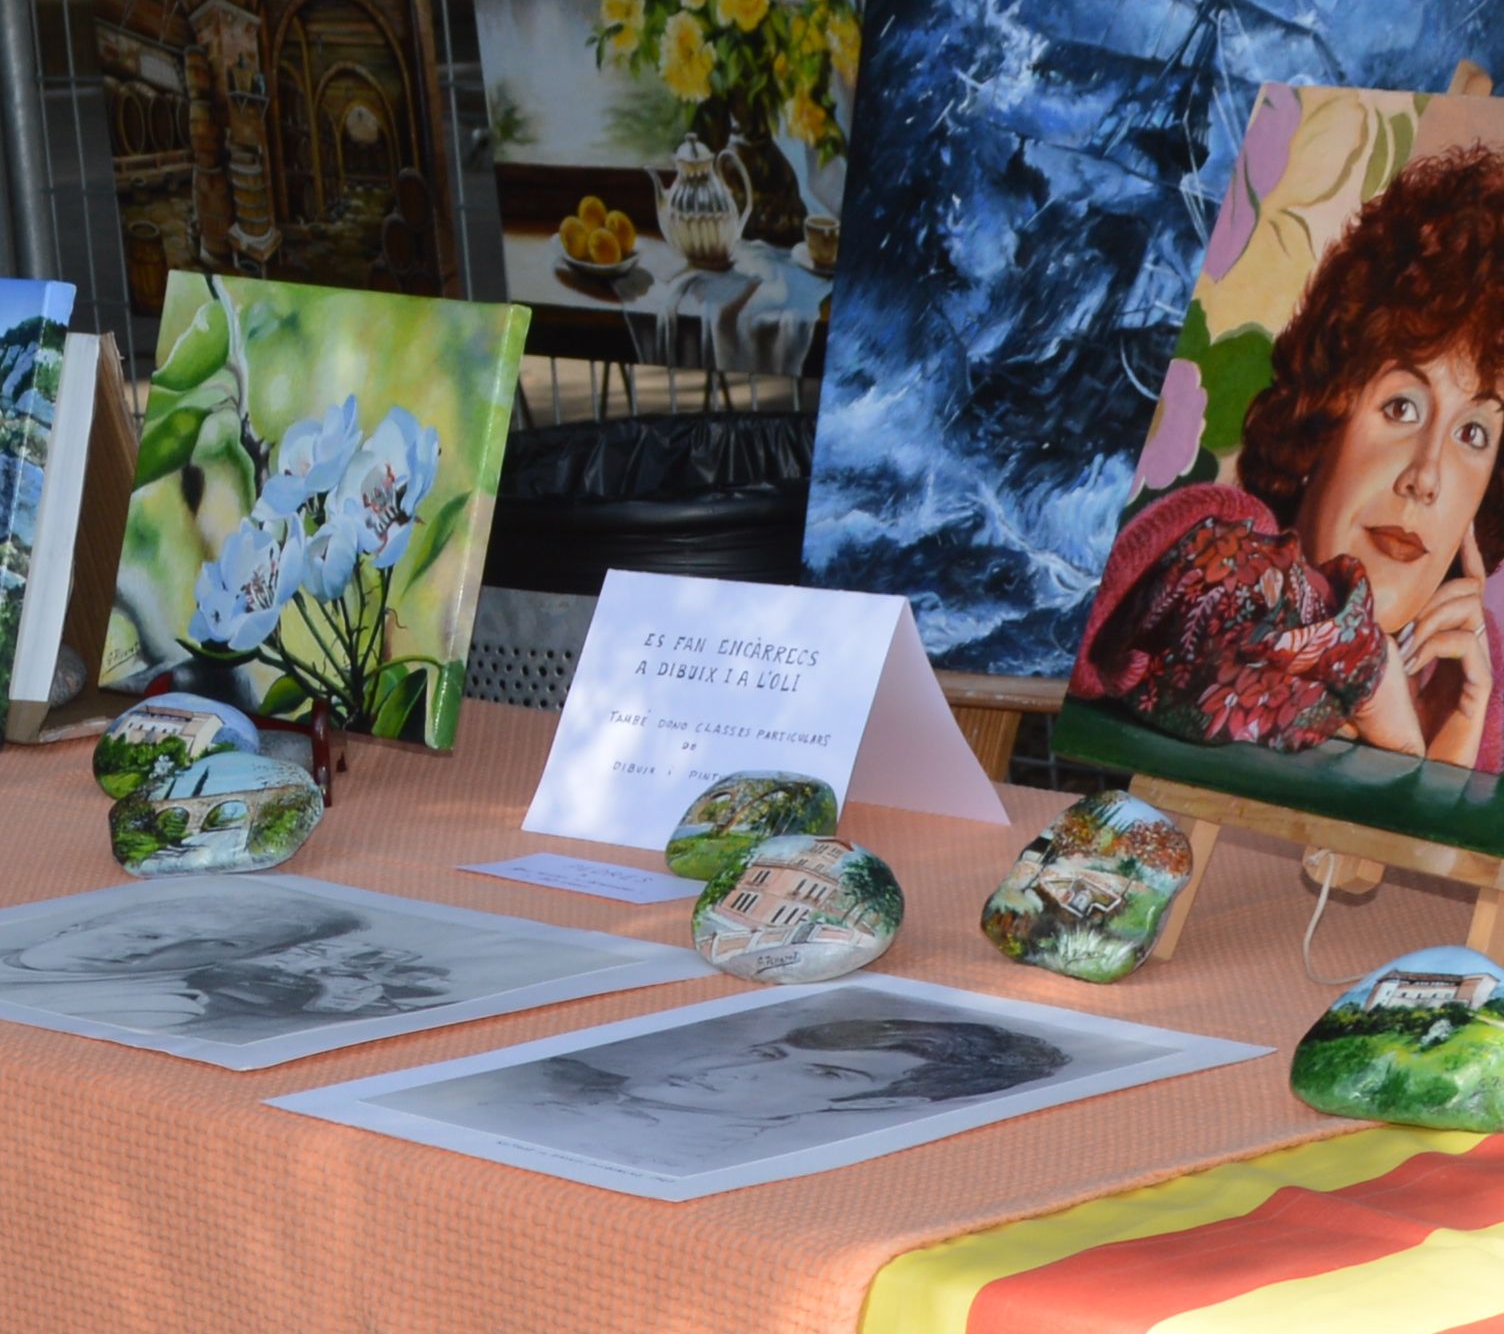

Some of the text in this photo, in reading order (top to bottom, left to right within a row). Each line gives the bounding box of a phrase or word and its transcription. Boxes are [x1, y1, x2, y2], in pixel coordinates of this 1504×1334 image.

[644, 632, 820, 668] ES FAN ENCÀRRECS
[635, 660, 648, 675] A
[657, 661, 716, 684] DIBUIX
[736, 670, 749, 687] A
[658, 718, 689, 732] DONO
[695, 722, 752, 739] CLASSES
